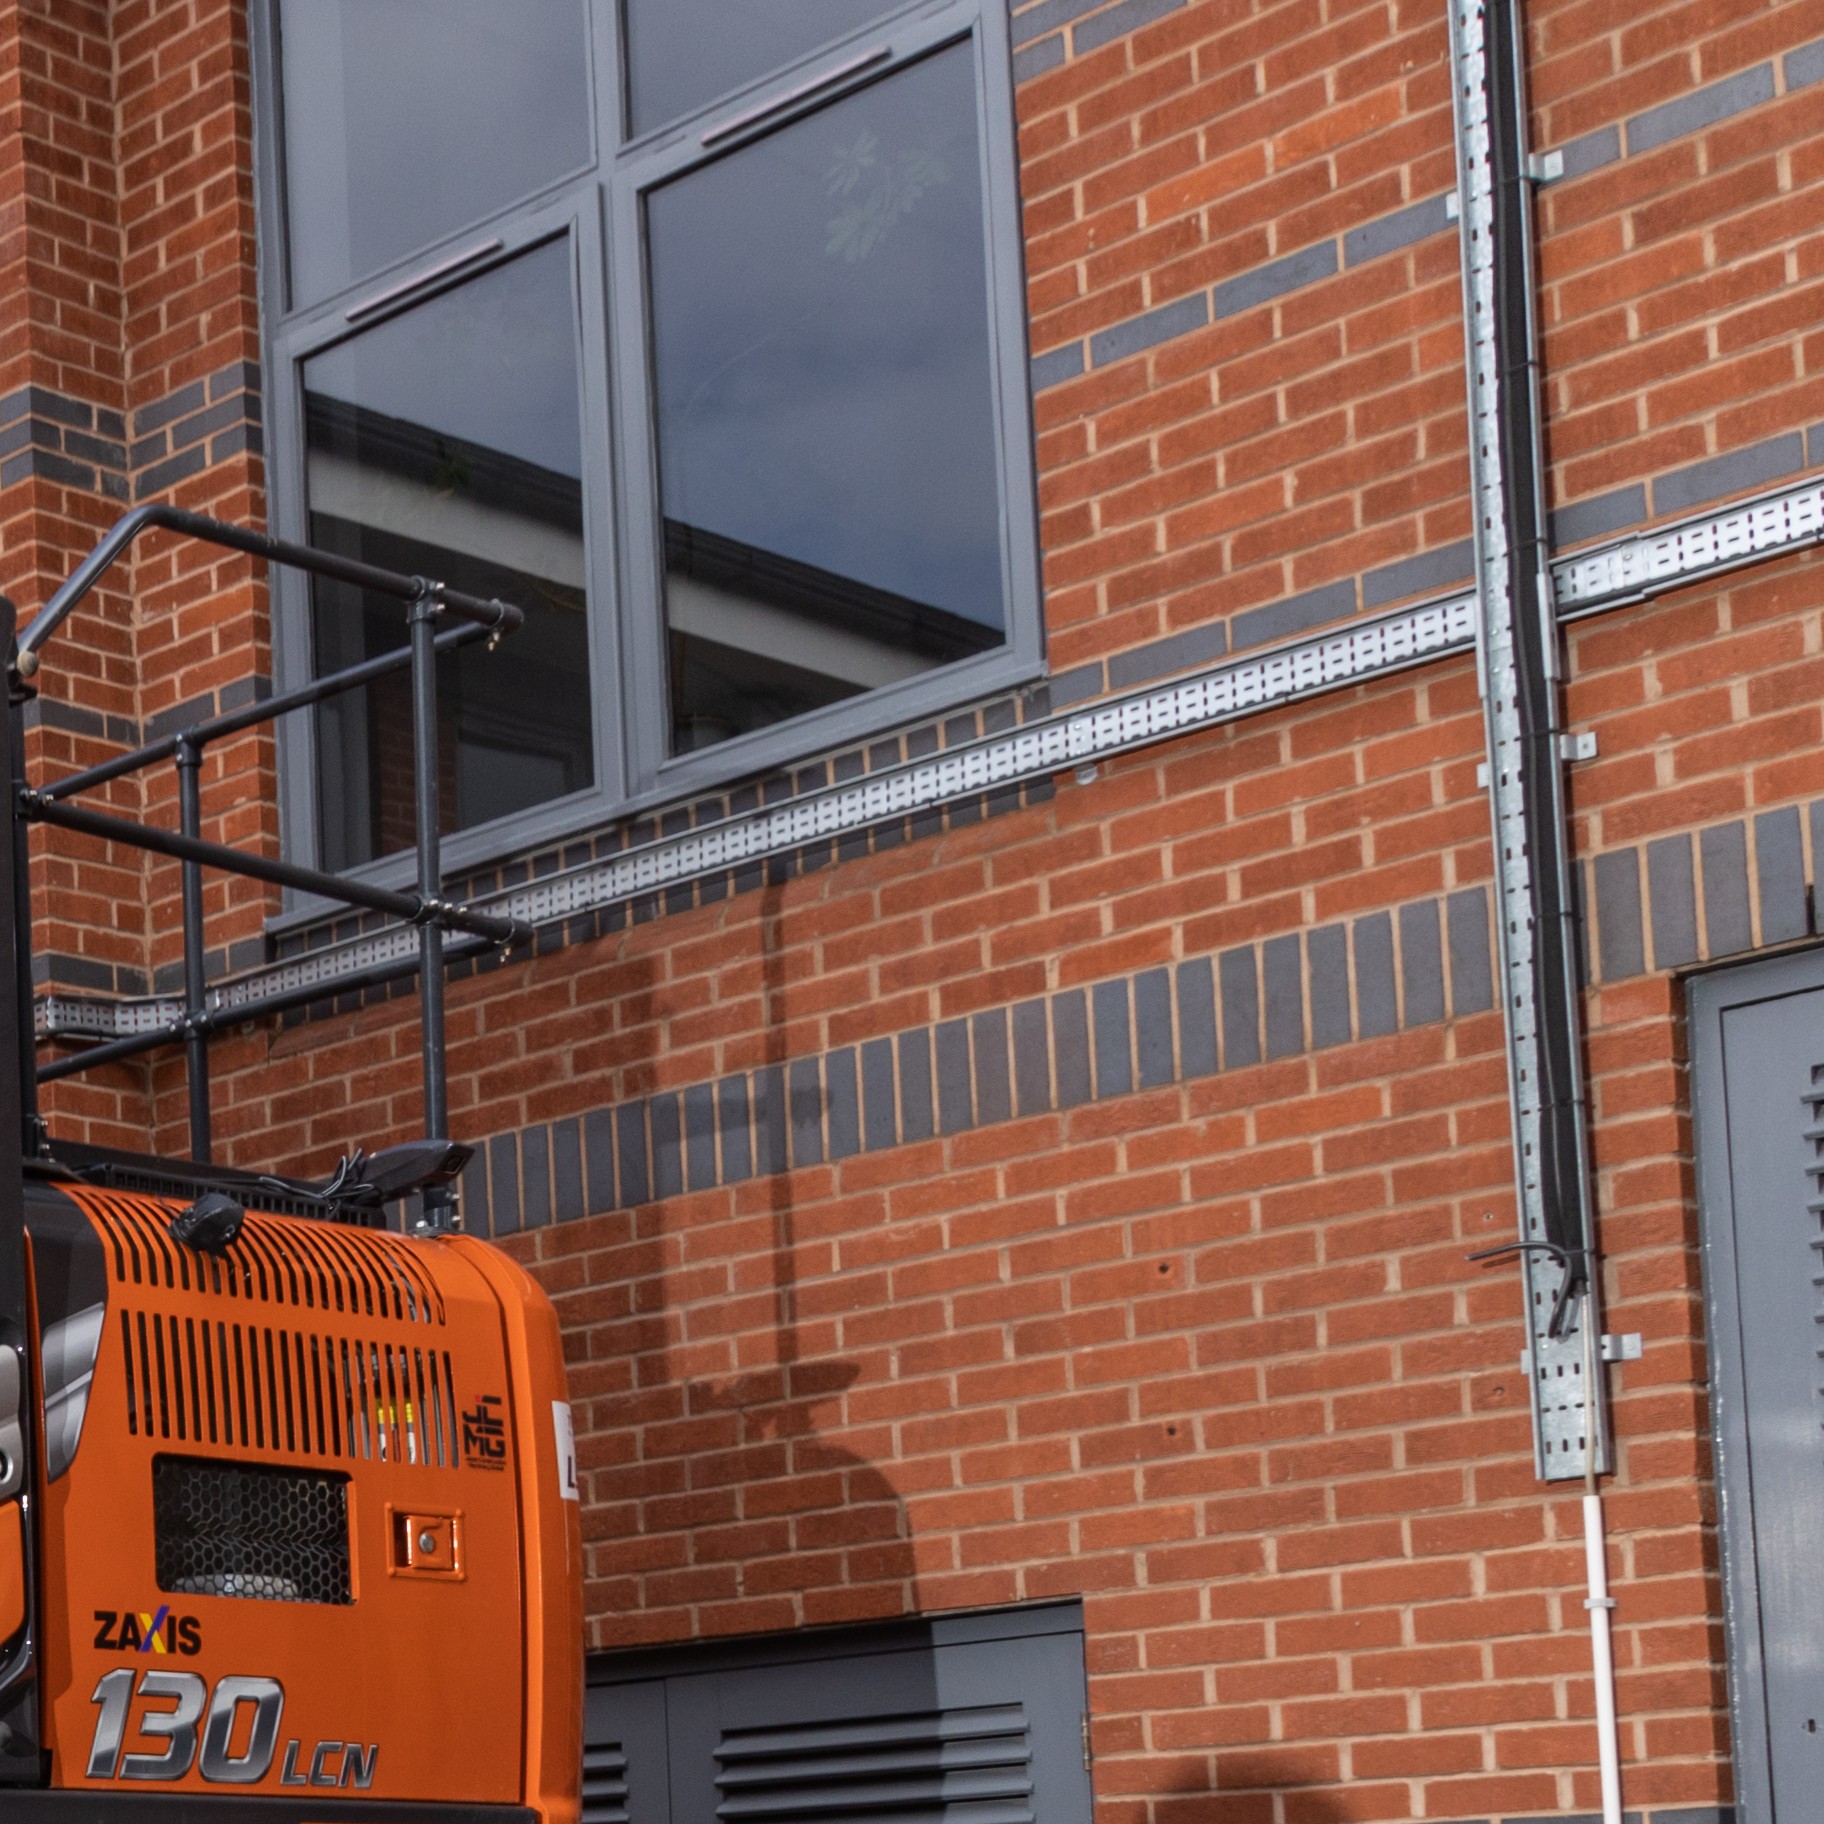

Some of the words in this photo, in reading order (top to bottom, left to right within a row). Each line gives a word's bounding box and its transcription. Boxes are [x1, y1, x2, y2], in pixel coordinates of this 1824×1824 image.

[94, 1605, 202, 1656] ZAXIS
[85, 1667, 286, 1785] 130
[280, 1739, 378, 1789] LCN
